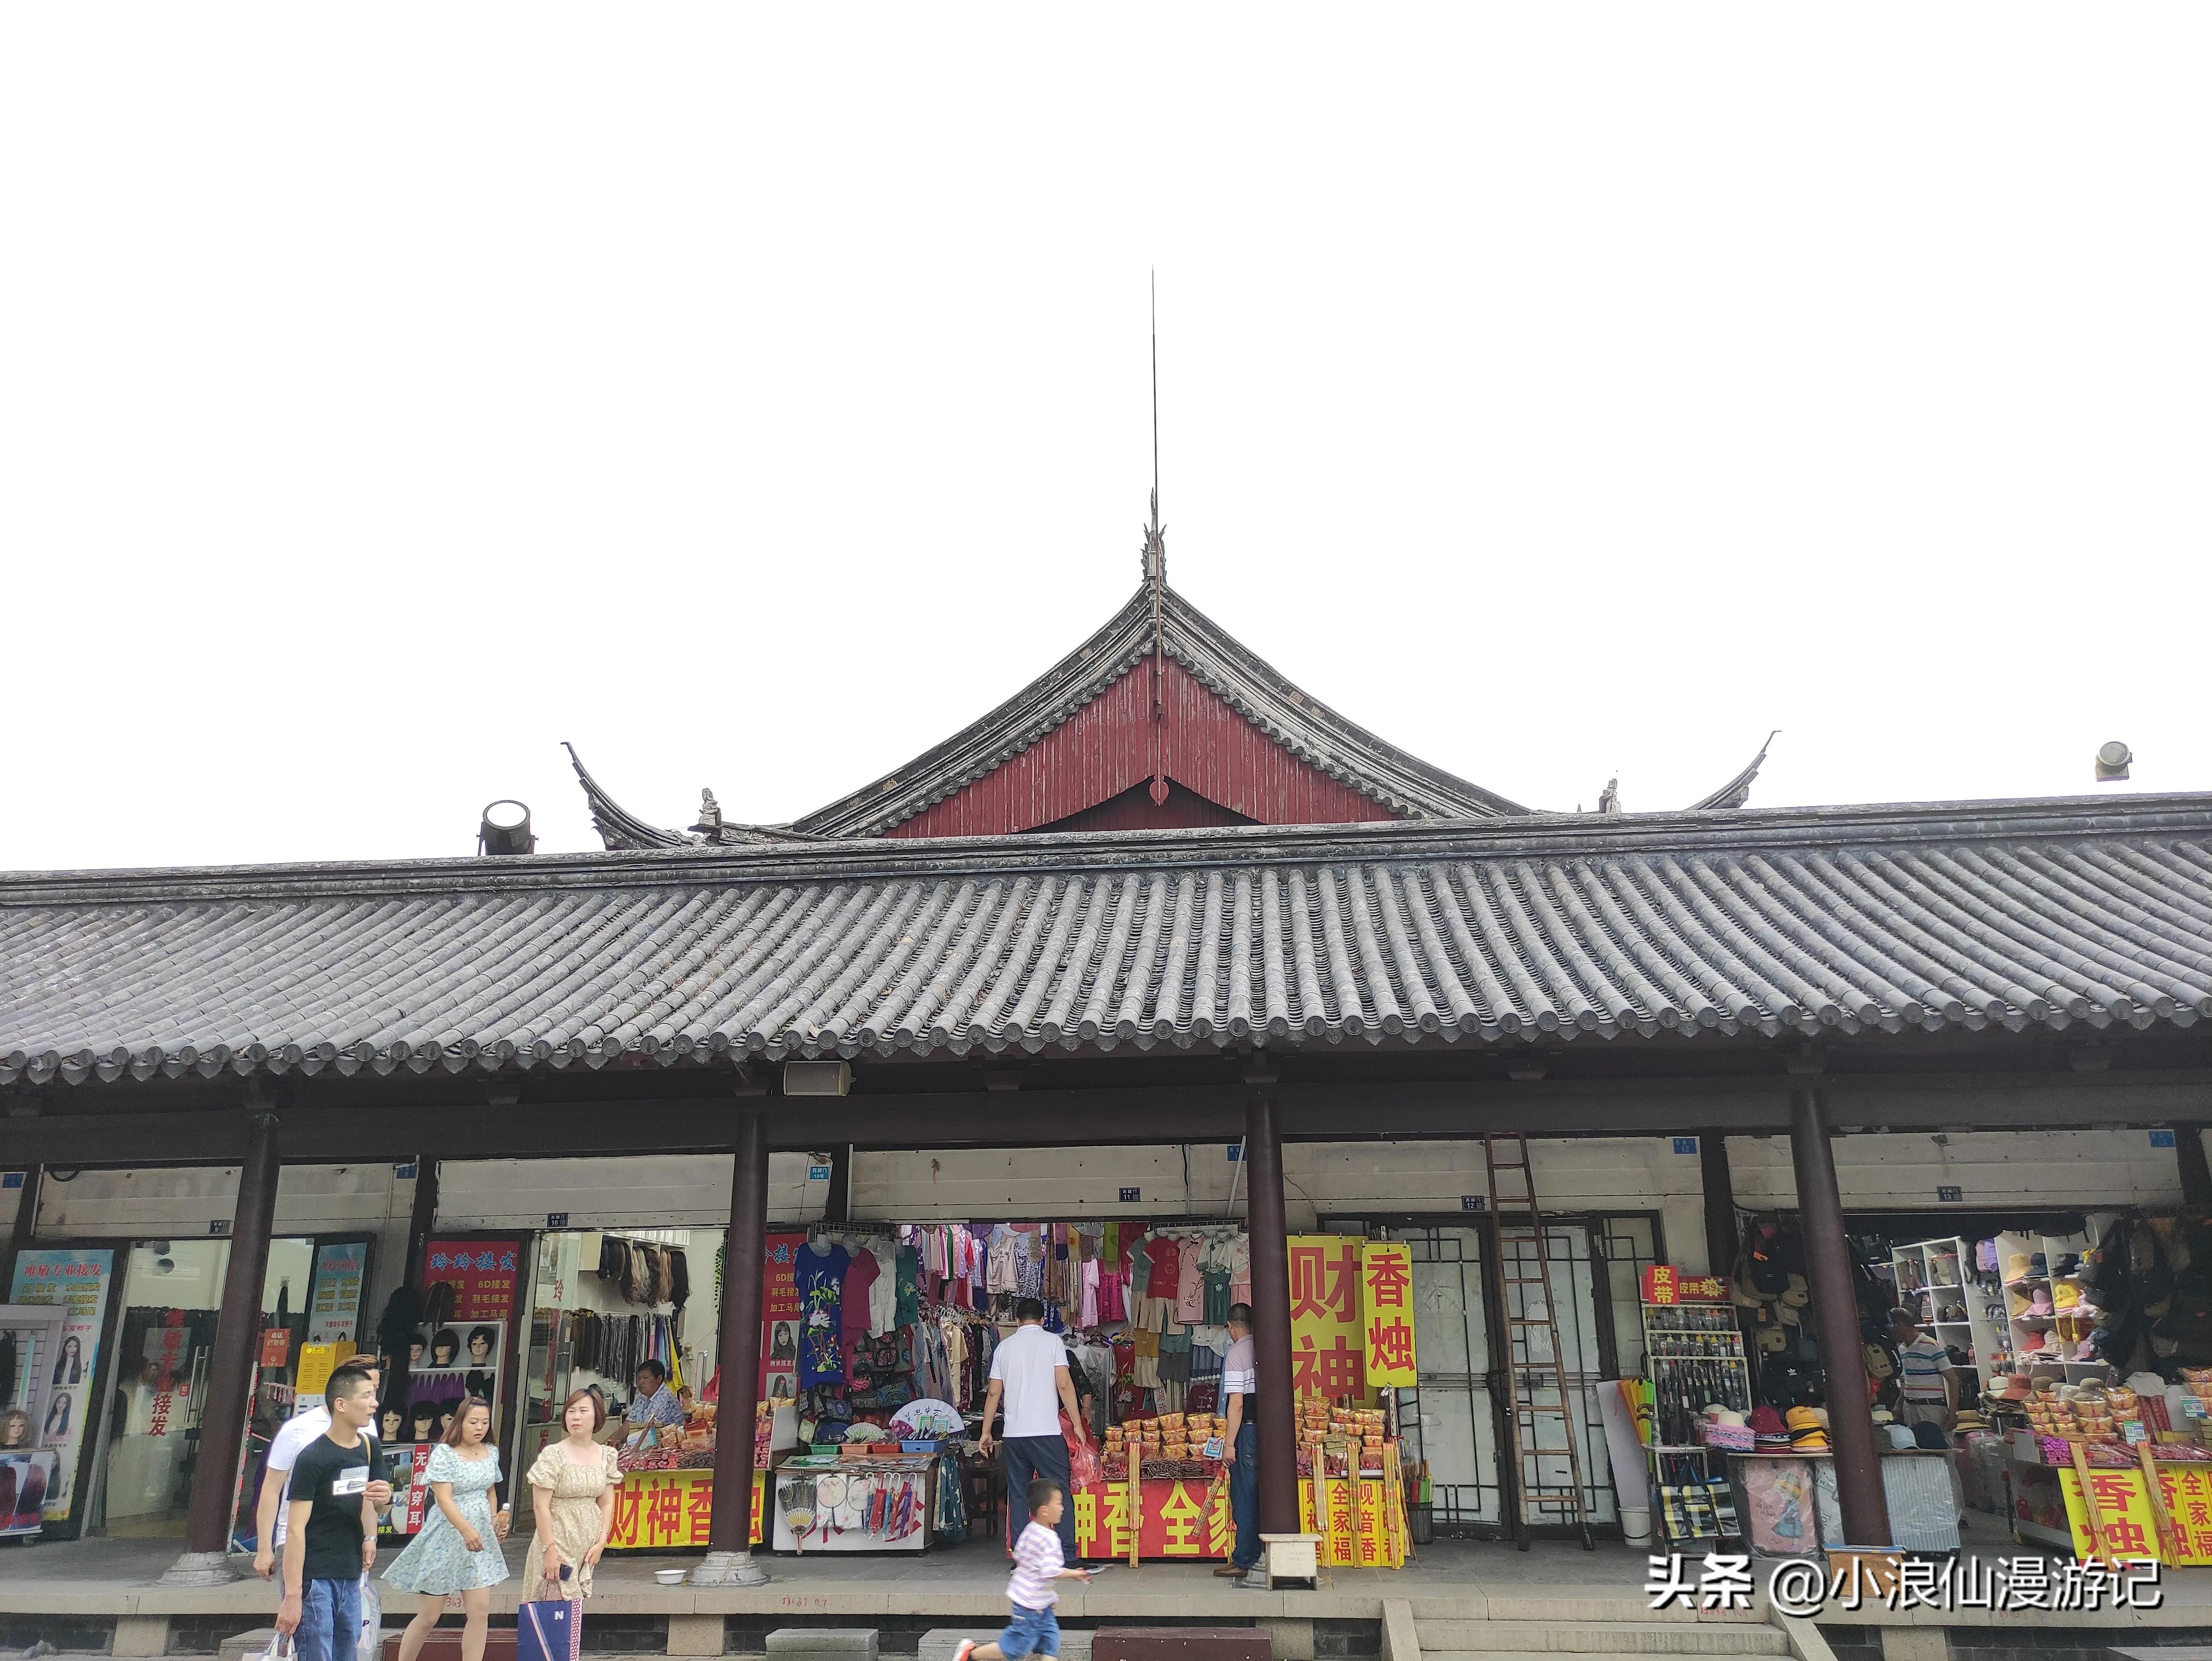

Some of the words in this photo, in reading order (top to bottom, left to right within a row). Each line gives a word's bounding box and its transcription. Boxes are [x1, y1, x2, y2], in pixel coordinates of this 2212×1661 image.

[430, 1251, 517, 1272] 玲玲接发
[472, 1294, 509, 1304] 羽毛接发
[478, 1280, 510, 1289] 6D接发
[1654, 1267, 1674, 1304] 皮带
[1705, 1283, 1716, 1292] 39
[1290, 1245, 1365, 1400] 财神
[1366, 1252, 1416, 1372] 香烛
[408, 1451, 427, 1526] 无痛穿耳
[1332, 1482, 1351, 1561] 全家福
[2071, 1474, 2152, 1555] 香烛
[554, 1610, 564, 1621] N
